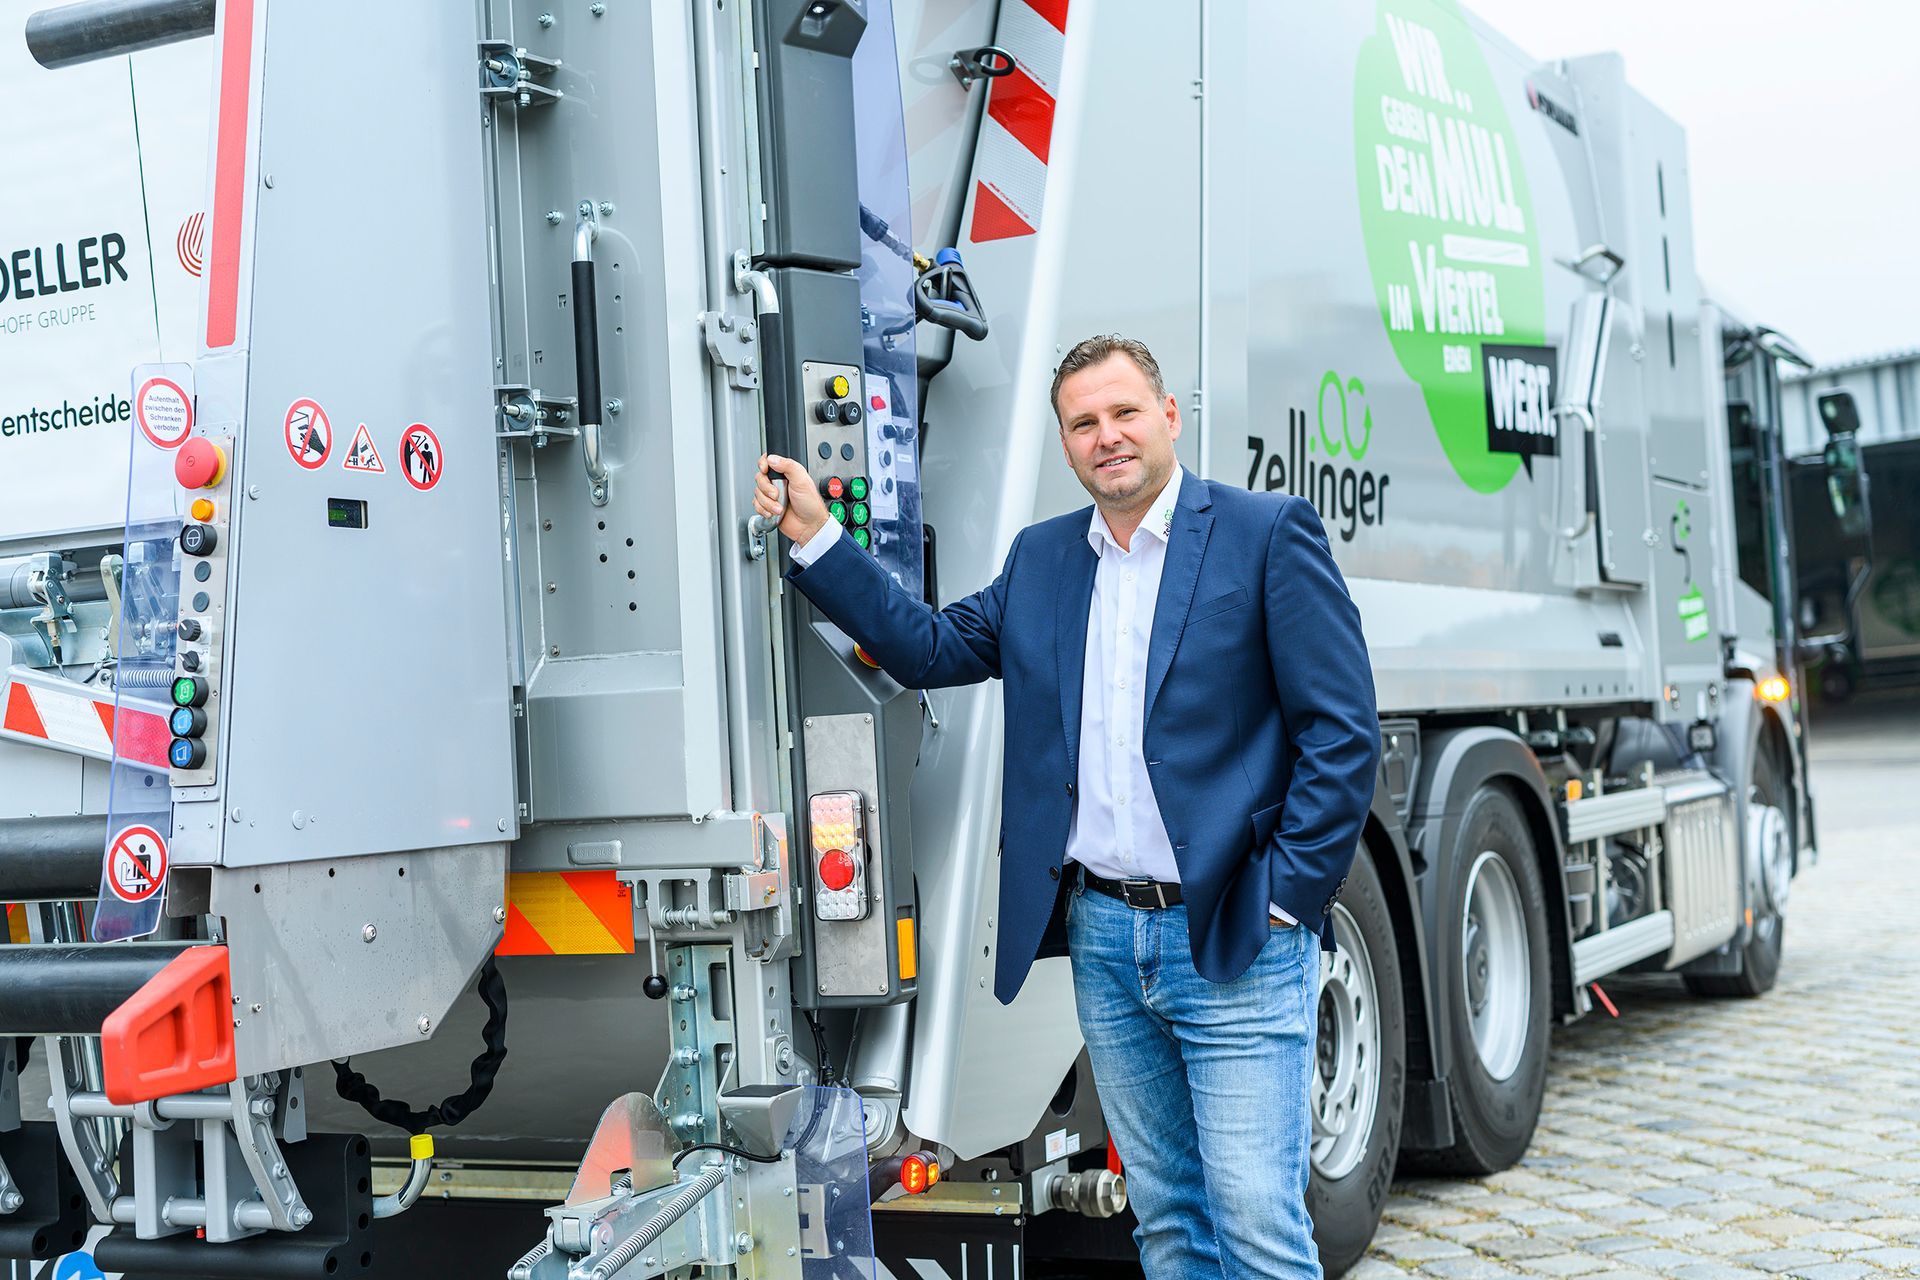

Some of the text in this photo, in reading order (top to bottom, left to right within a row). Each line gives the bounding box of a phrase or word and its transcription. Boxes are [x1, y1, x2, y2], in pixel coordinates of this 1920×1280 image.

[1375, 143, 1437, 219] DEM
[38, 303, 96, 329] GRUPPE
[1388, 283, 1414, 332] IM
[148, 394, 180, 405] Aufenthalt
[1, 393, 133, 437] entscheide
[145, 404, 186, 414] zwischen den
[149, 413, 182, 423] Schranken
[153, 423, 180, 432] verboten
